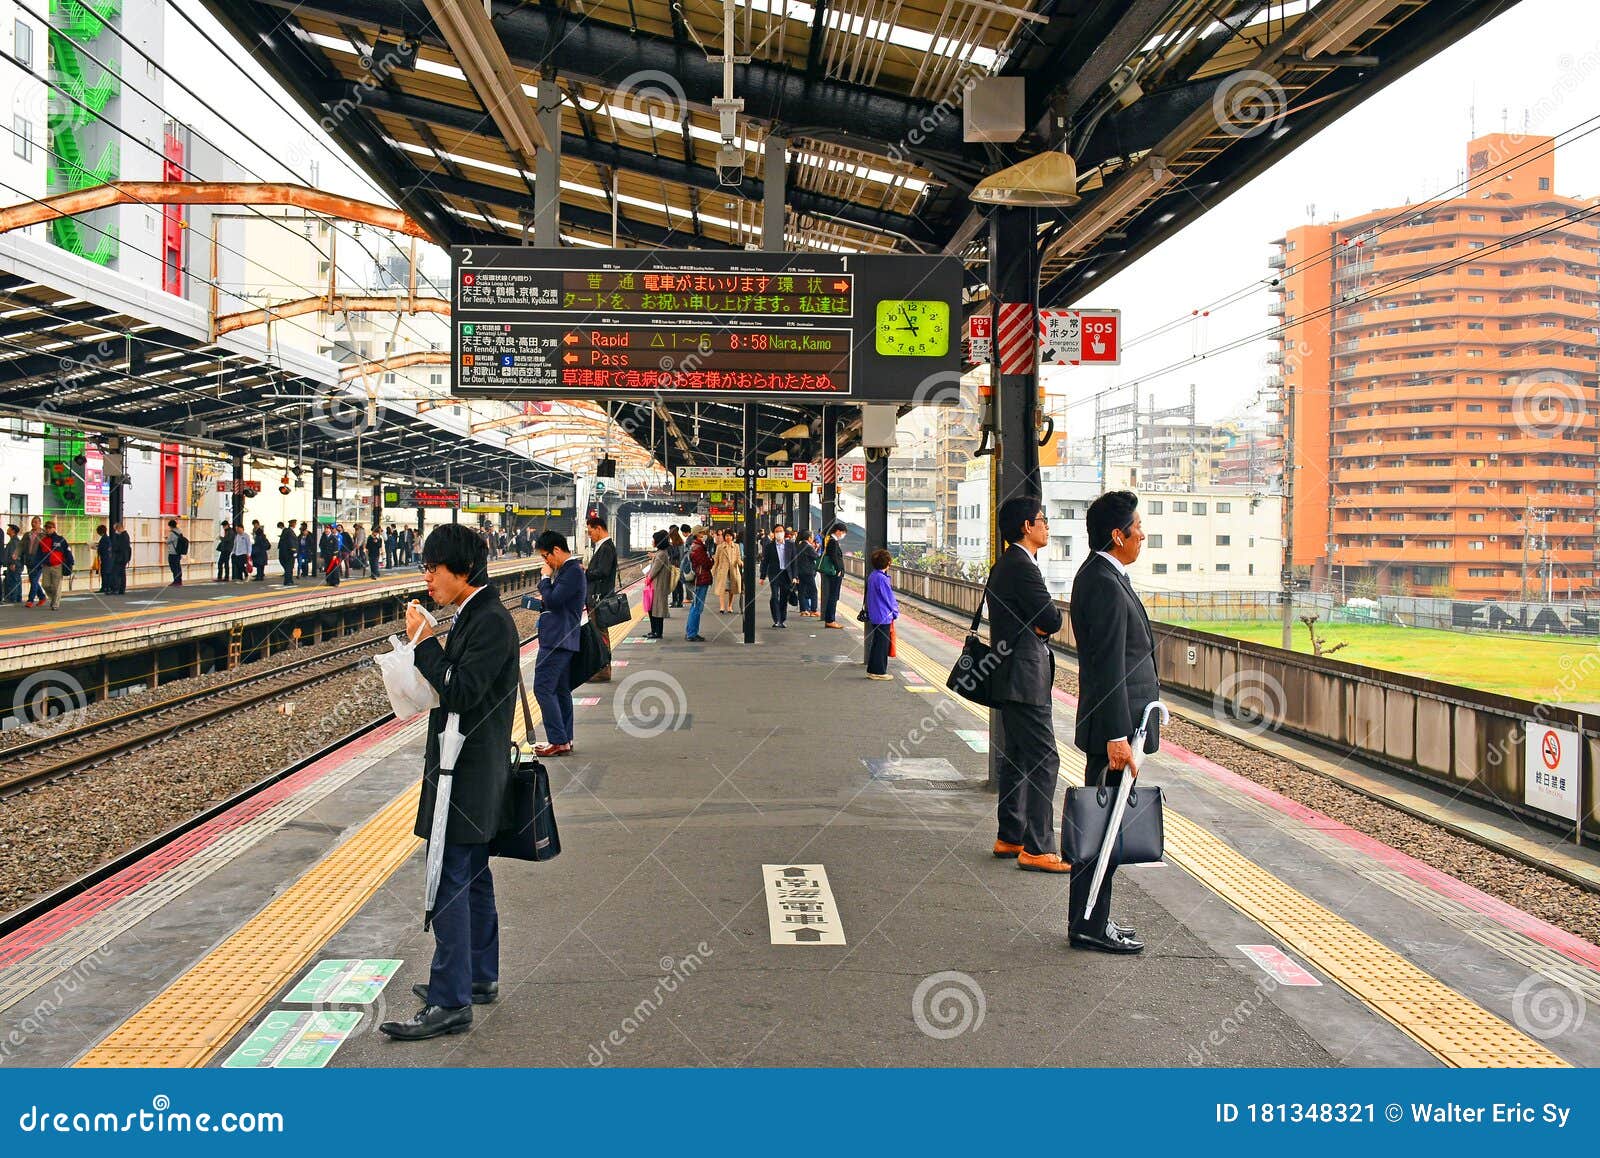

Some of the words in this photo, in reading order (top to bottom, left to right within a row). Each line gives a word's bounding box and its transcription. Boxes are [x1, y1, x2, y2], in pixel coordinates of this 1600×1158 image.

[462, 248, 473, 264] 2
[840, 255, 847, 271] 1
[587, 273, 635, 290] 普通
[643, 273, 770, 293] 電車がまいります
[1049, 319, 1079, 328] 非常
[1085, 323, 1113, 334] SOS
[1049, 329, 1079, 338] ボタン
[591, 331, 629, 350] Rapid
[730, 334, 767, 350] 8:58
[1049, 339, 1079, 347] Emergency
[504, 356, 510, 365] S
[591, 350, 629, 367] Pass
[679, 468, 686, 478] 2
[1188, 651, 1195, 661] 9
